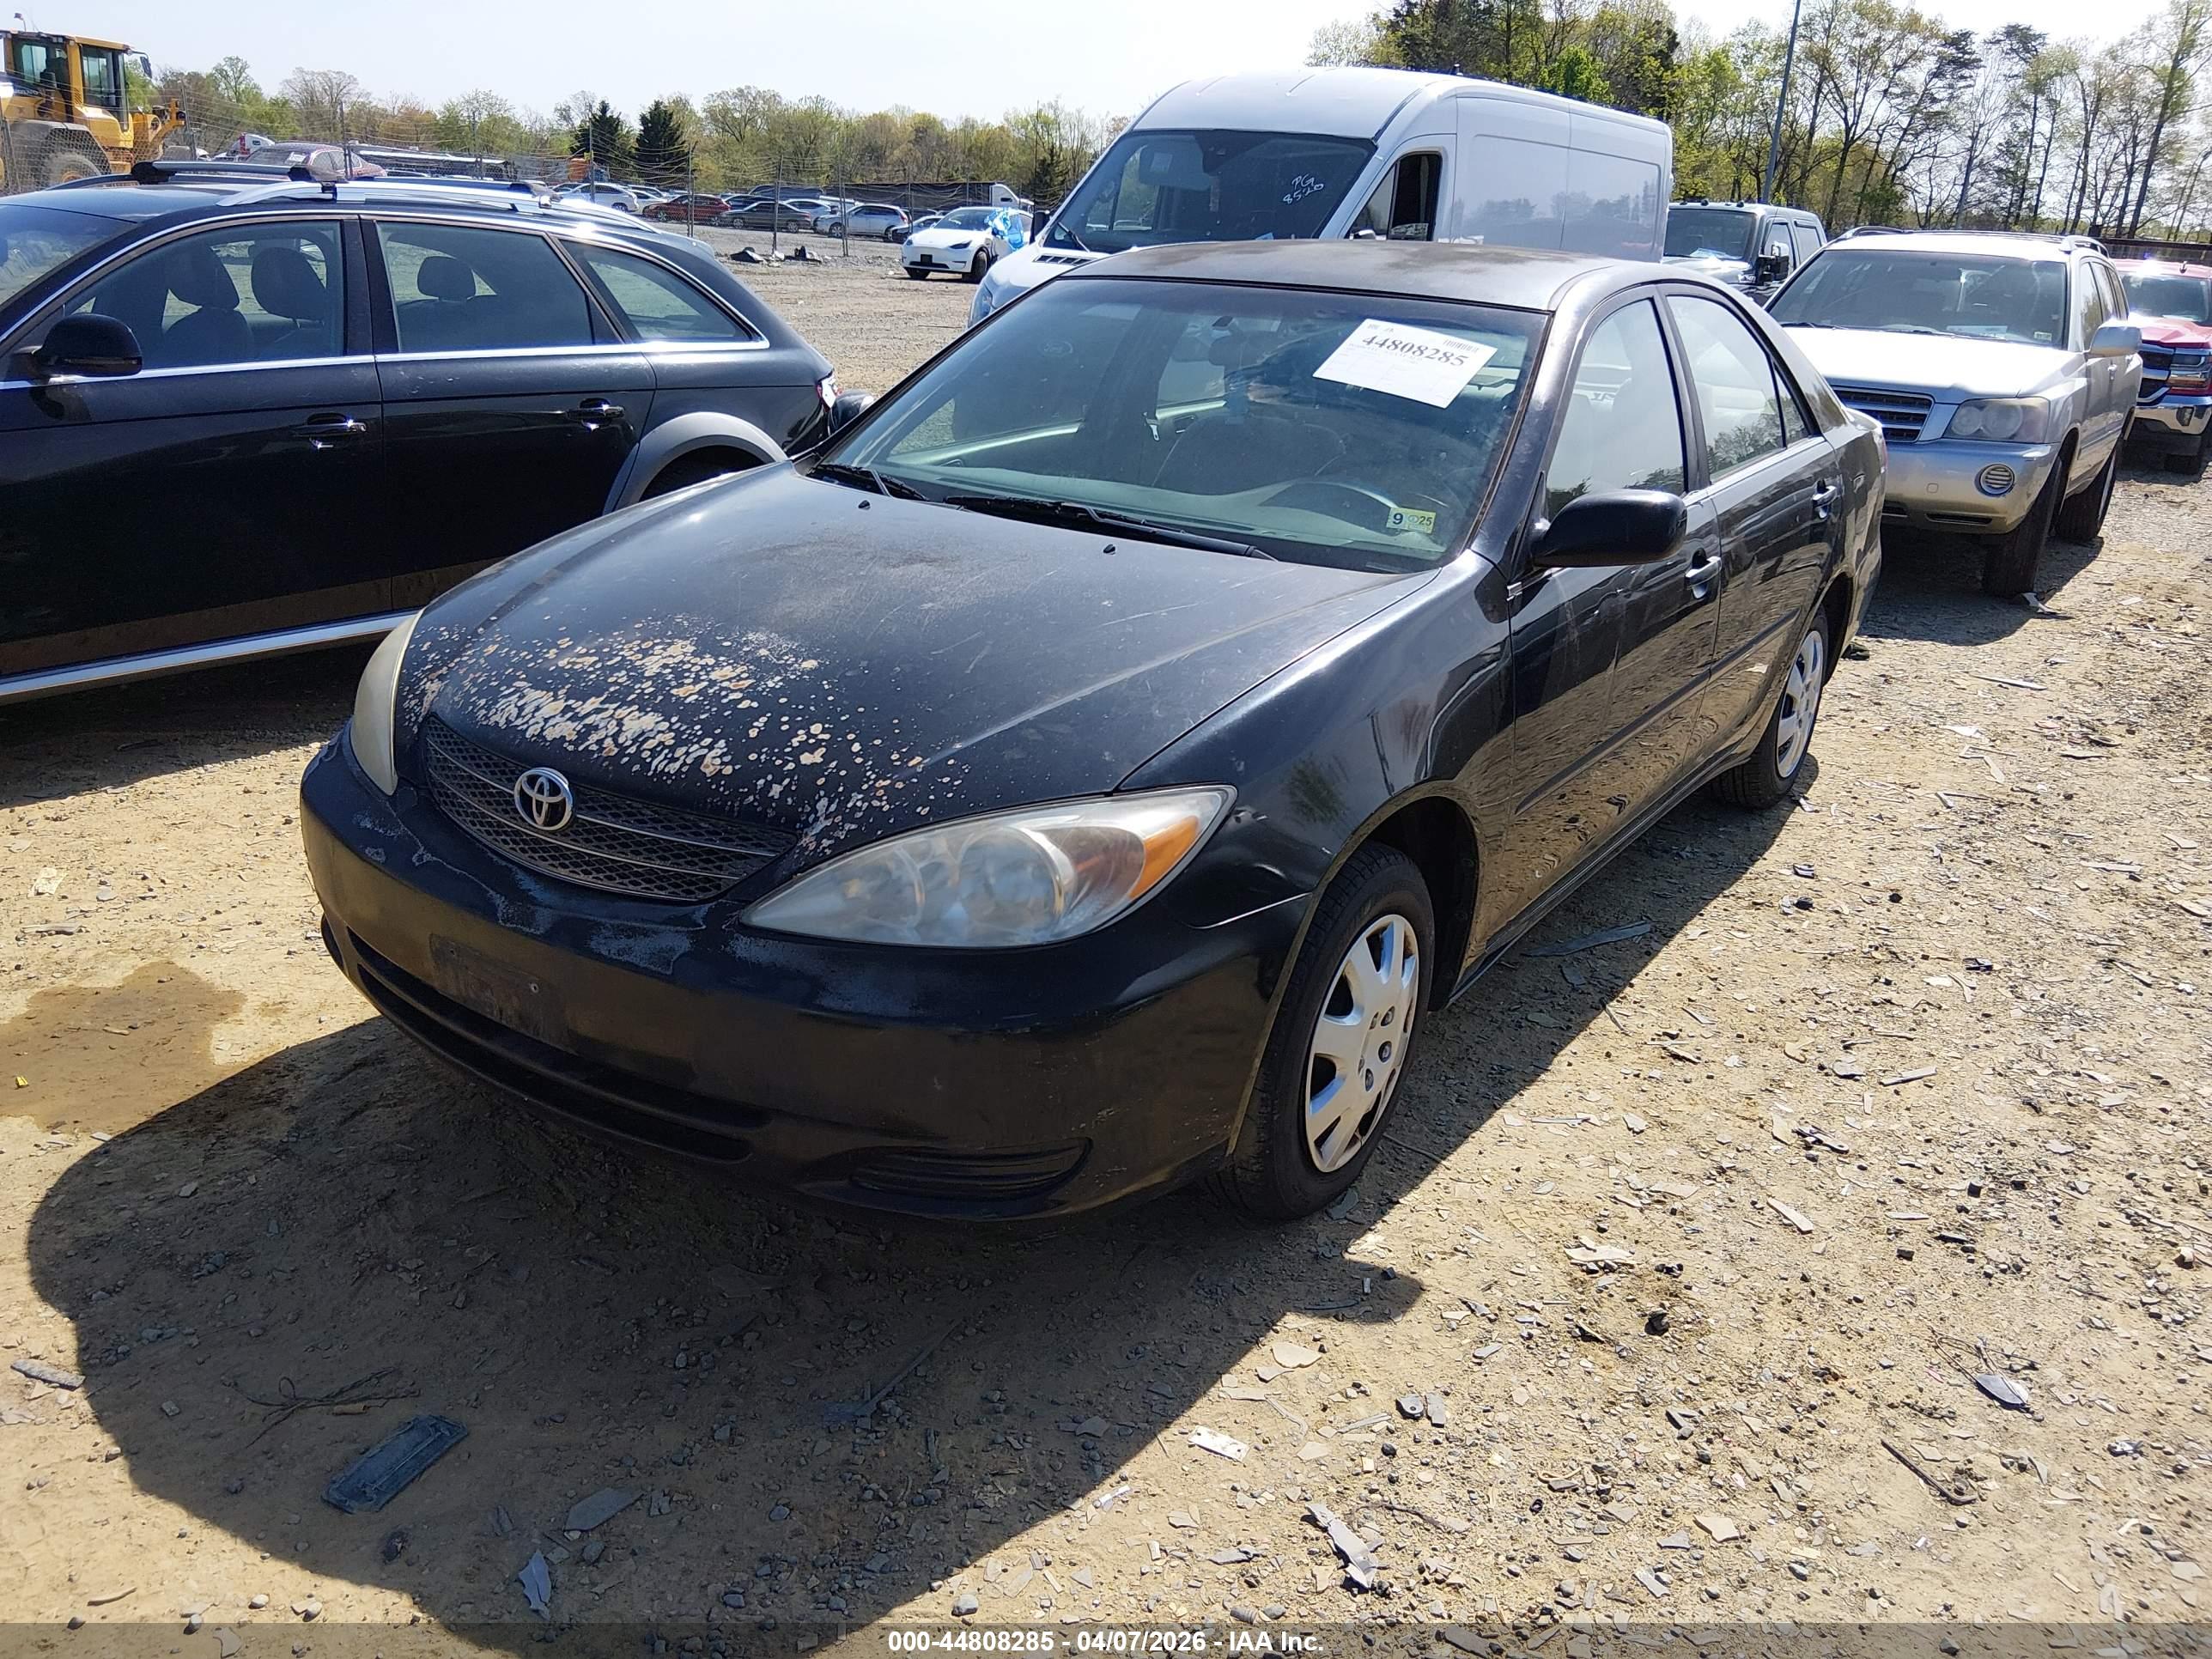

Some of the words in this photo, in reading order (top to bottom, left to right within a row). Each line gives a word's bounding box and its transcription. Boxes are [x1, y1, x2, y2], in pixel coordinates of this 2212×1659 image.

[1362, 334, 1470, 368] 44808285
[1393, 513, 1404, 525] 9
[1419, 515, 1433, 526] 25
